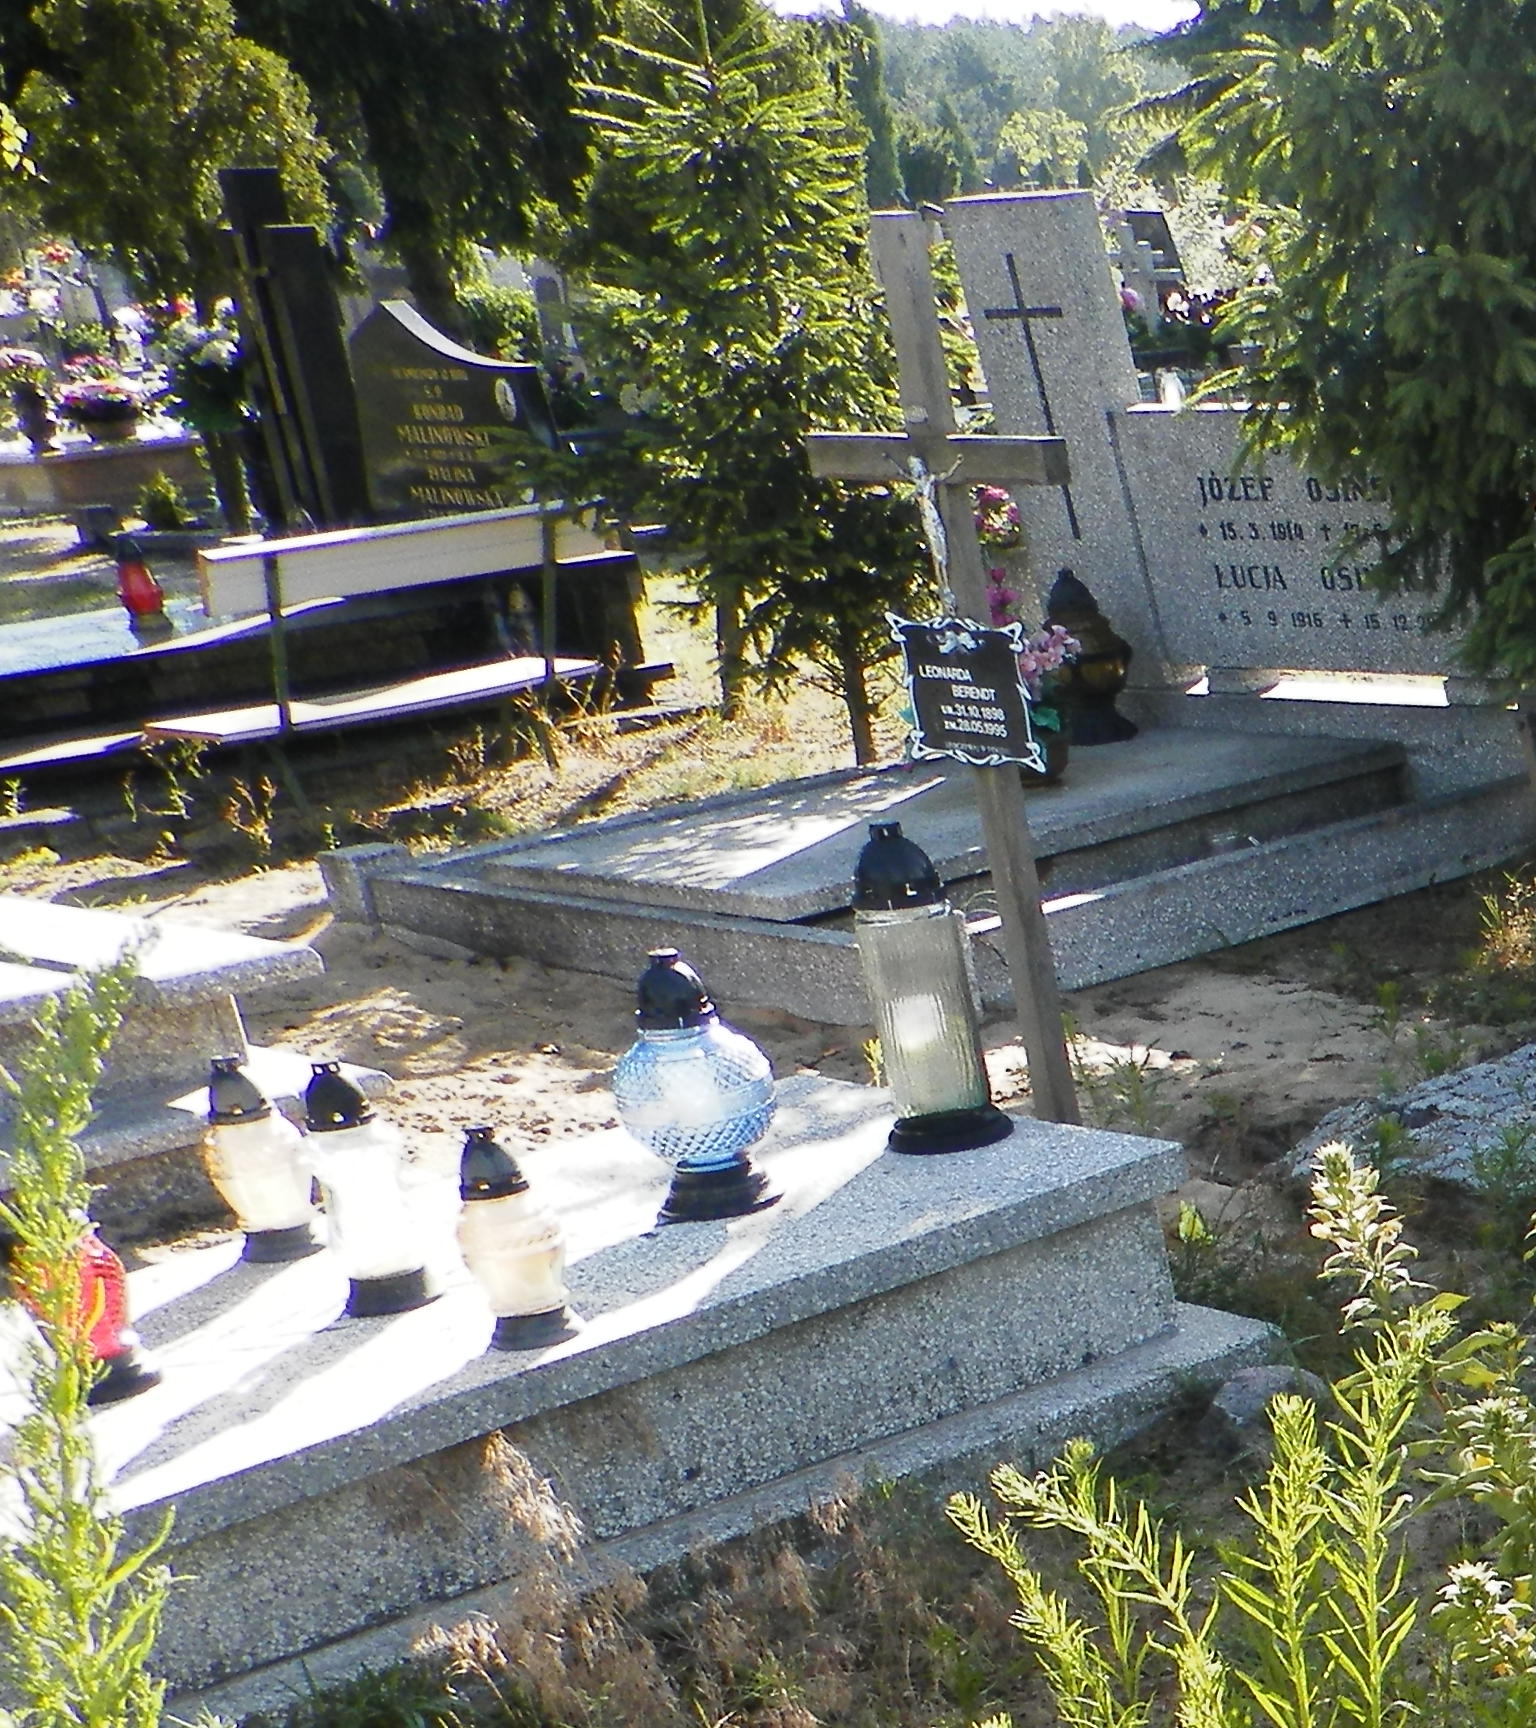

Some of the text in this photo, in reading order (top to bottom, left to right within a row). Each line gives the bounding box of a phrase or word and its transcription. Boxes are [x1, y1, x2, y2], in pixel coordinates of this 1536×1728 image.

[1197, 469, 1274, 507] JÓZEF
[918, 664, 973, 682] LEONARDA
[951, 684, 996, 702] BERENDT
